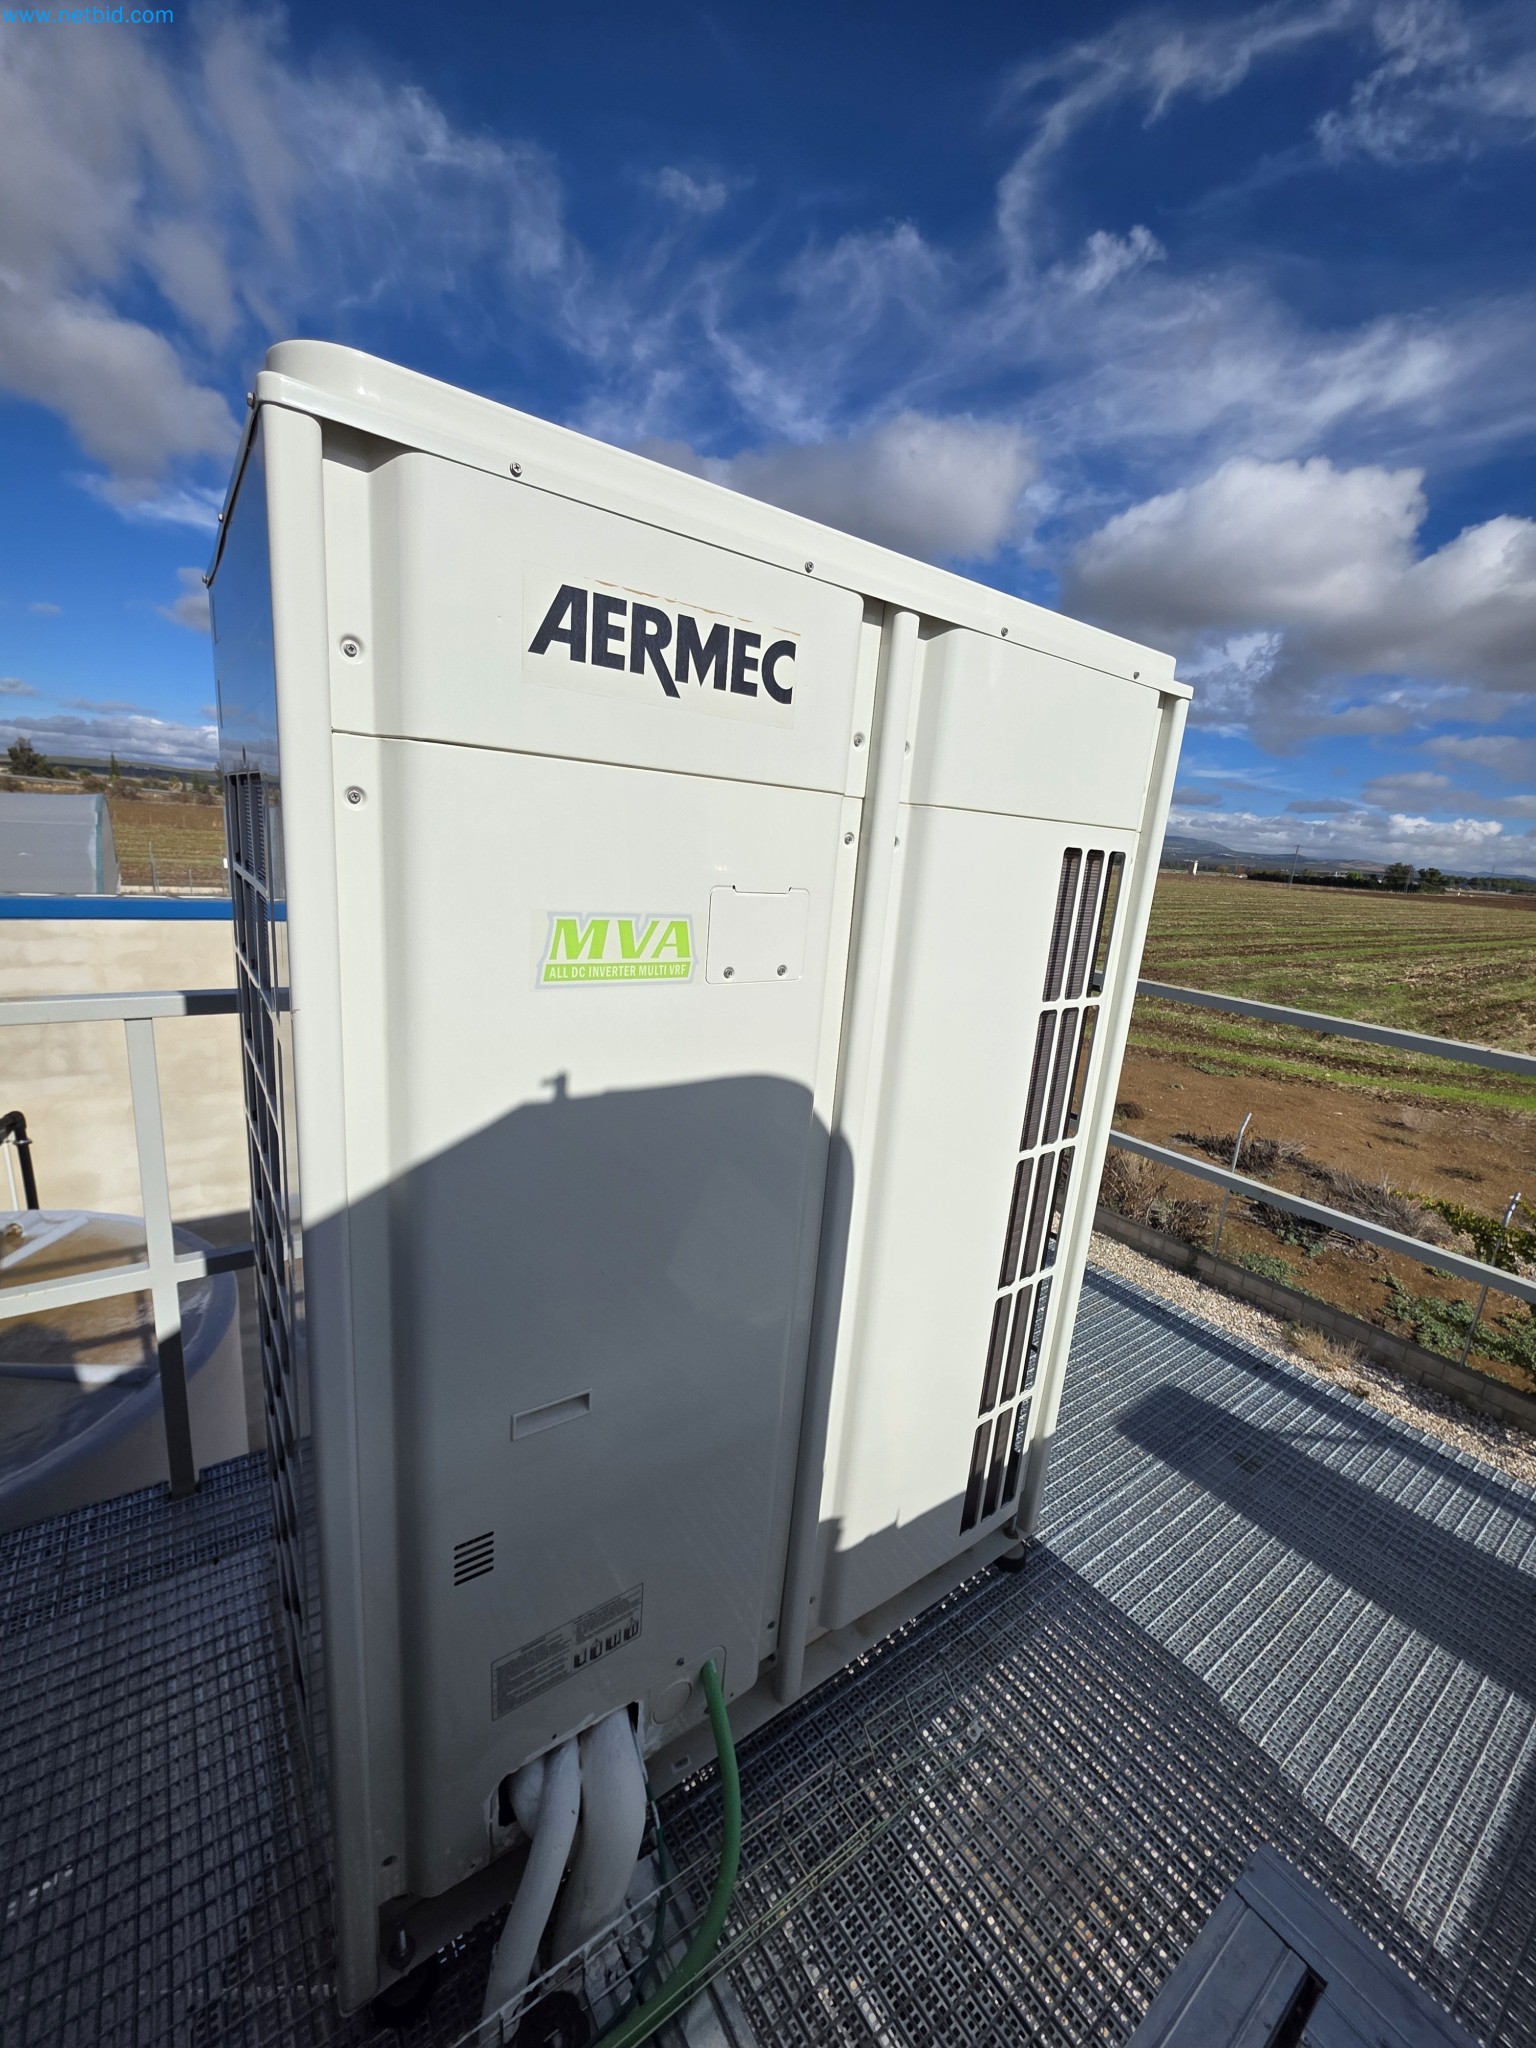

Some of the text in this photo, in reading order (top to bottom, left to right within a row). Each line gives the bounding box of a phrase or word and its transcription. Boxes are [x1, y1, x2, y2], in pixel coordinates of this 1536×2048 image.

[527, 584, 796, 705] AERMEC
[549, 919, 691, 960] MVA
[549, 964, 687, 979] ALL DC INVERTER MULTI VRF
